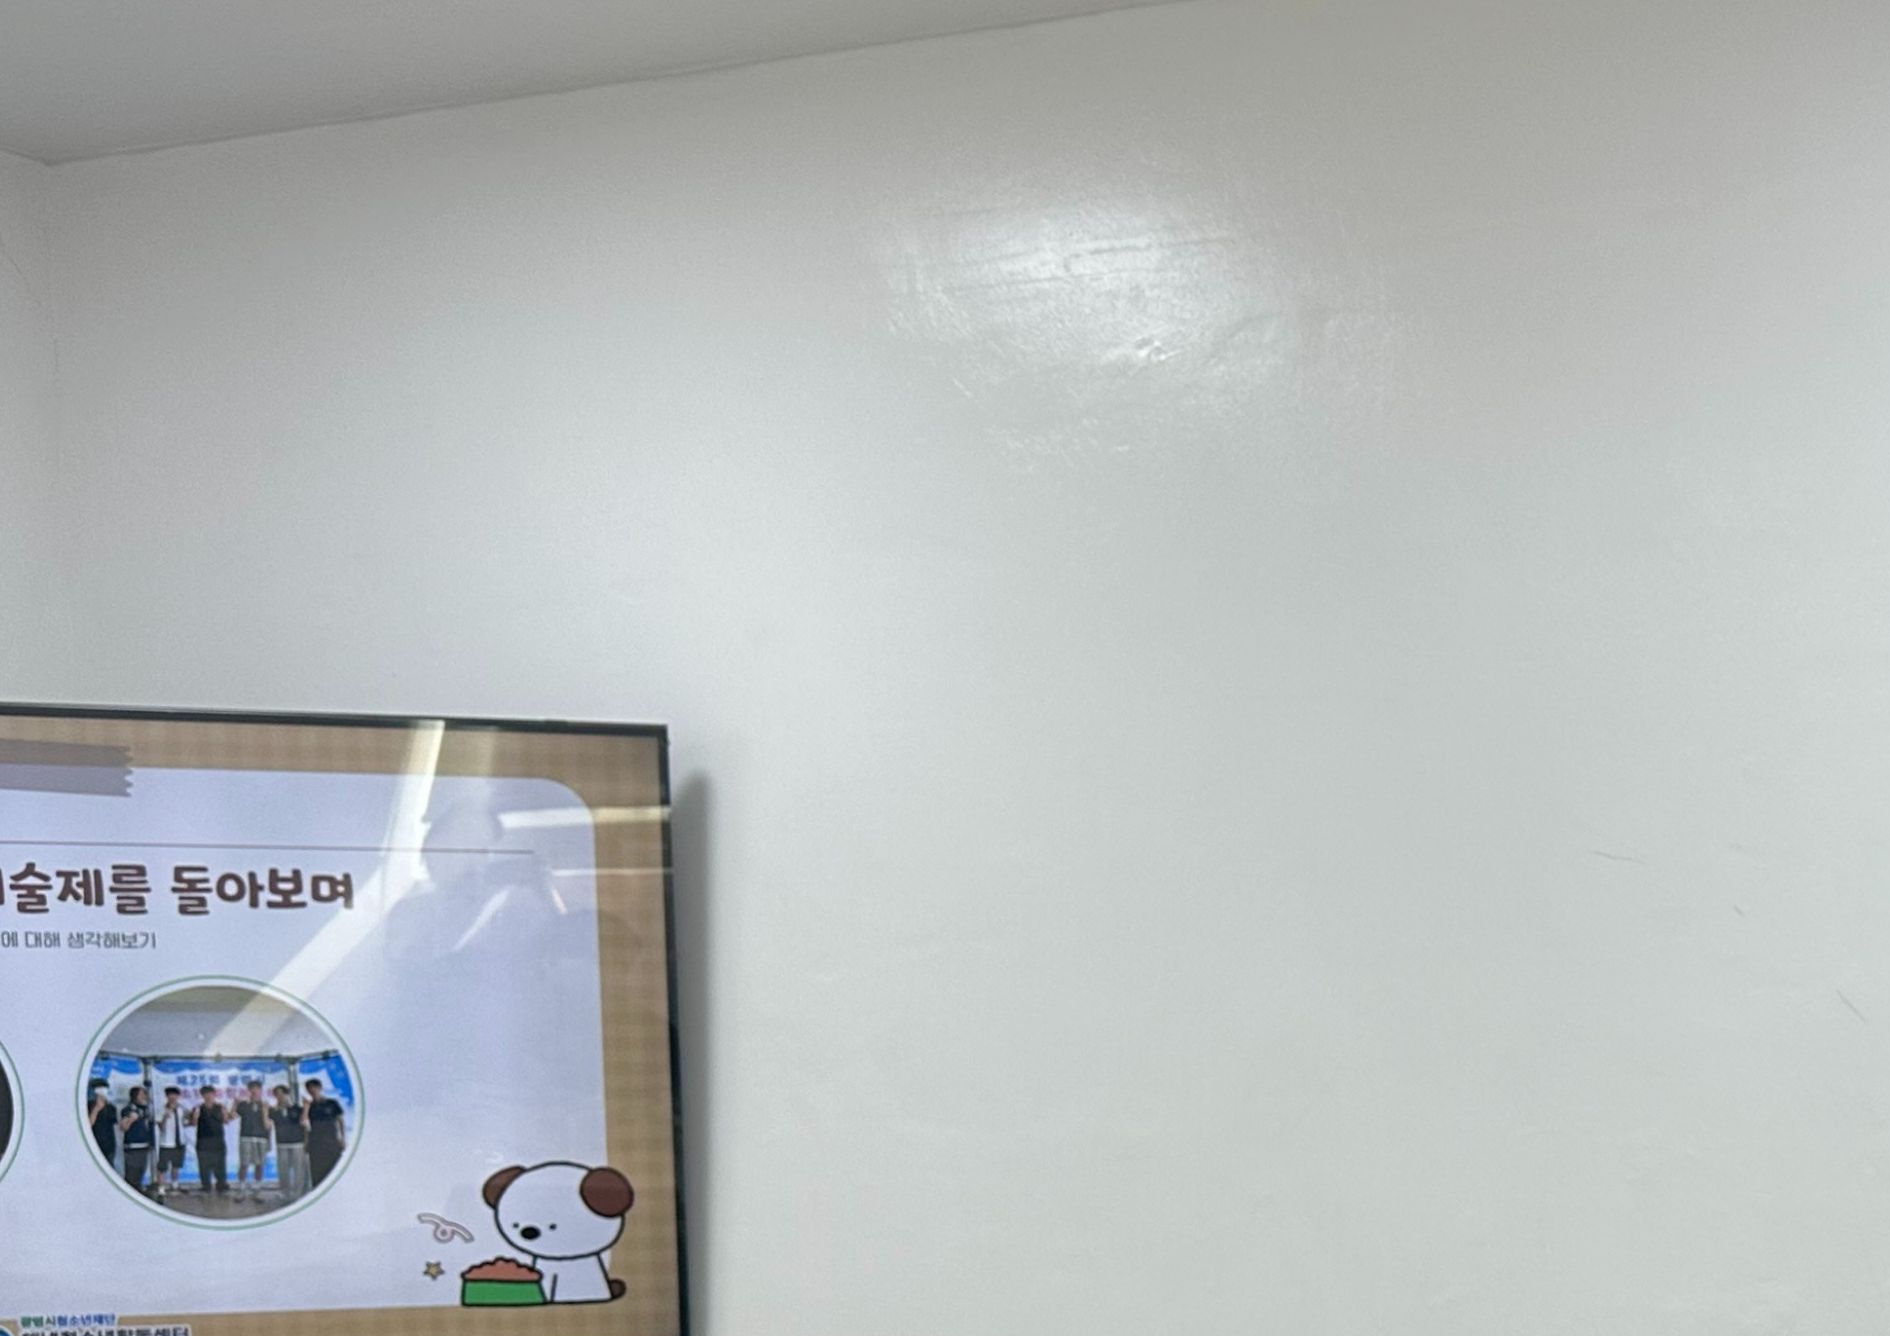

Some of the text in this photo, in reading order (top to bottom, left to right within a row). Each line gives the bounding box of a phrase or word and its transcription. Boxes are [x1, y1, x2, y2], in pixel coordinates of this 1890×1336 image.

[0, 861, 355, 916] 술제를 돌아보며
[25, 930, 61, 949] 대해
[68, 930, 156, 949] 생각해보기
